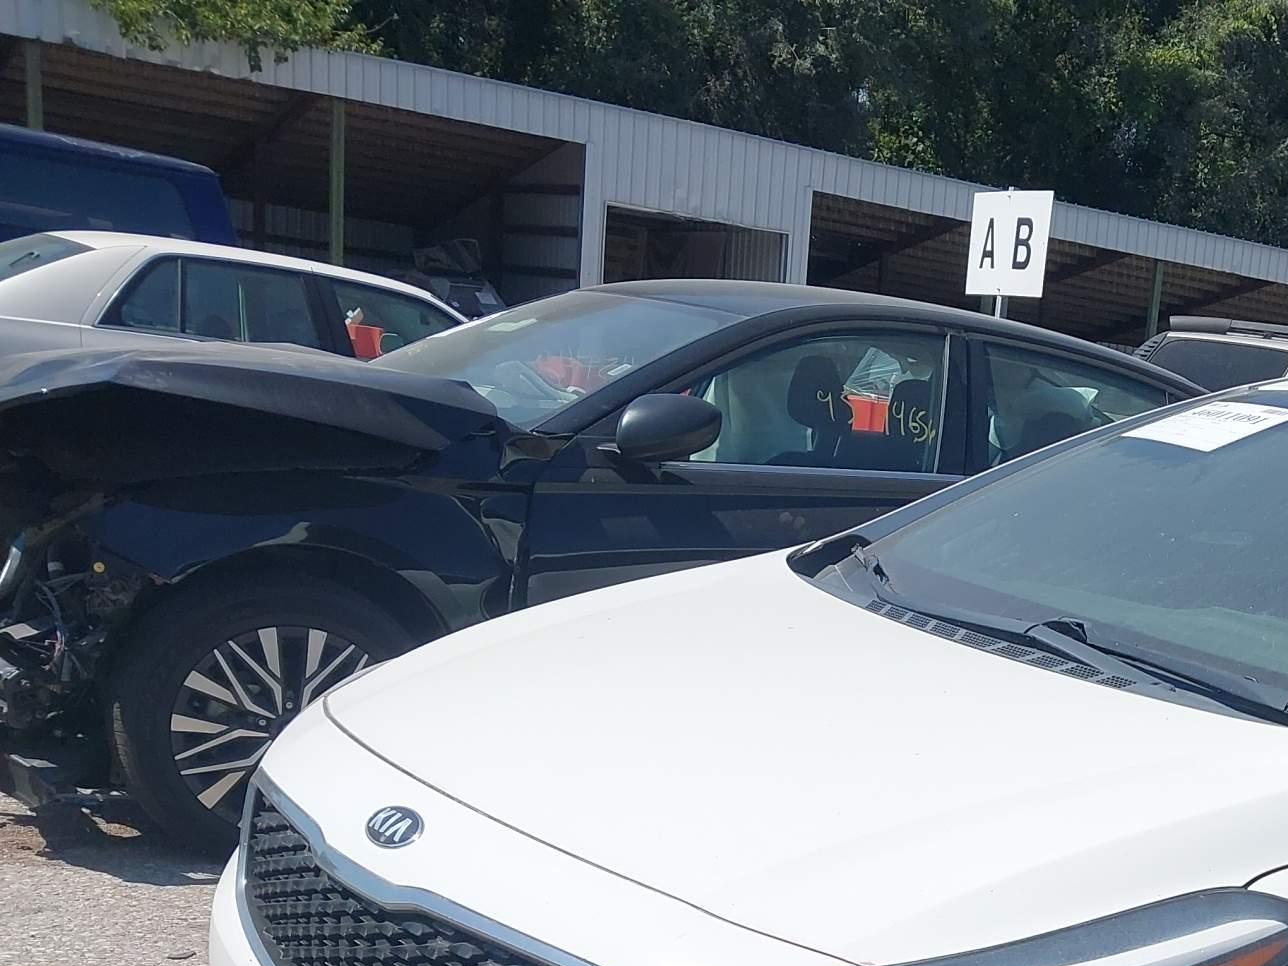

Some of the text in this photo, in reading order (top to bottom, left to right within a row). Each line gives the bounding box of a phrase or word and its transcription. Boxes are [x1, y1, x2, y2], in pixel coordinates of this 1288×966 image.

[979, 217, 1034, 270] A B
[368, 807, 413, 842] KIA
